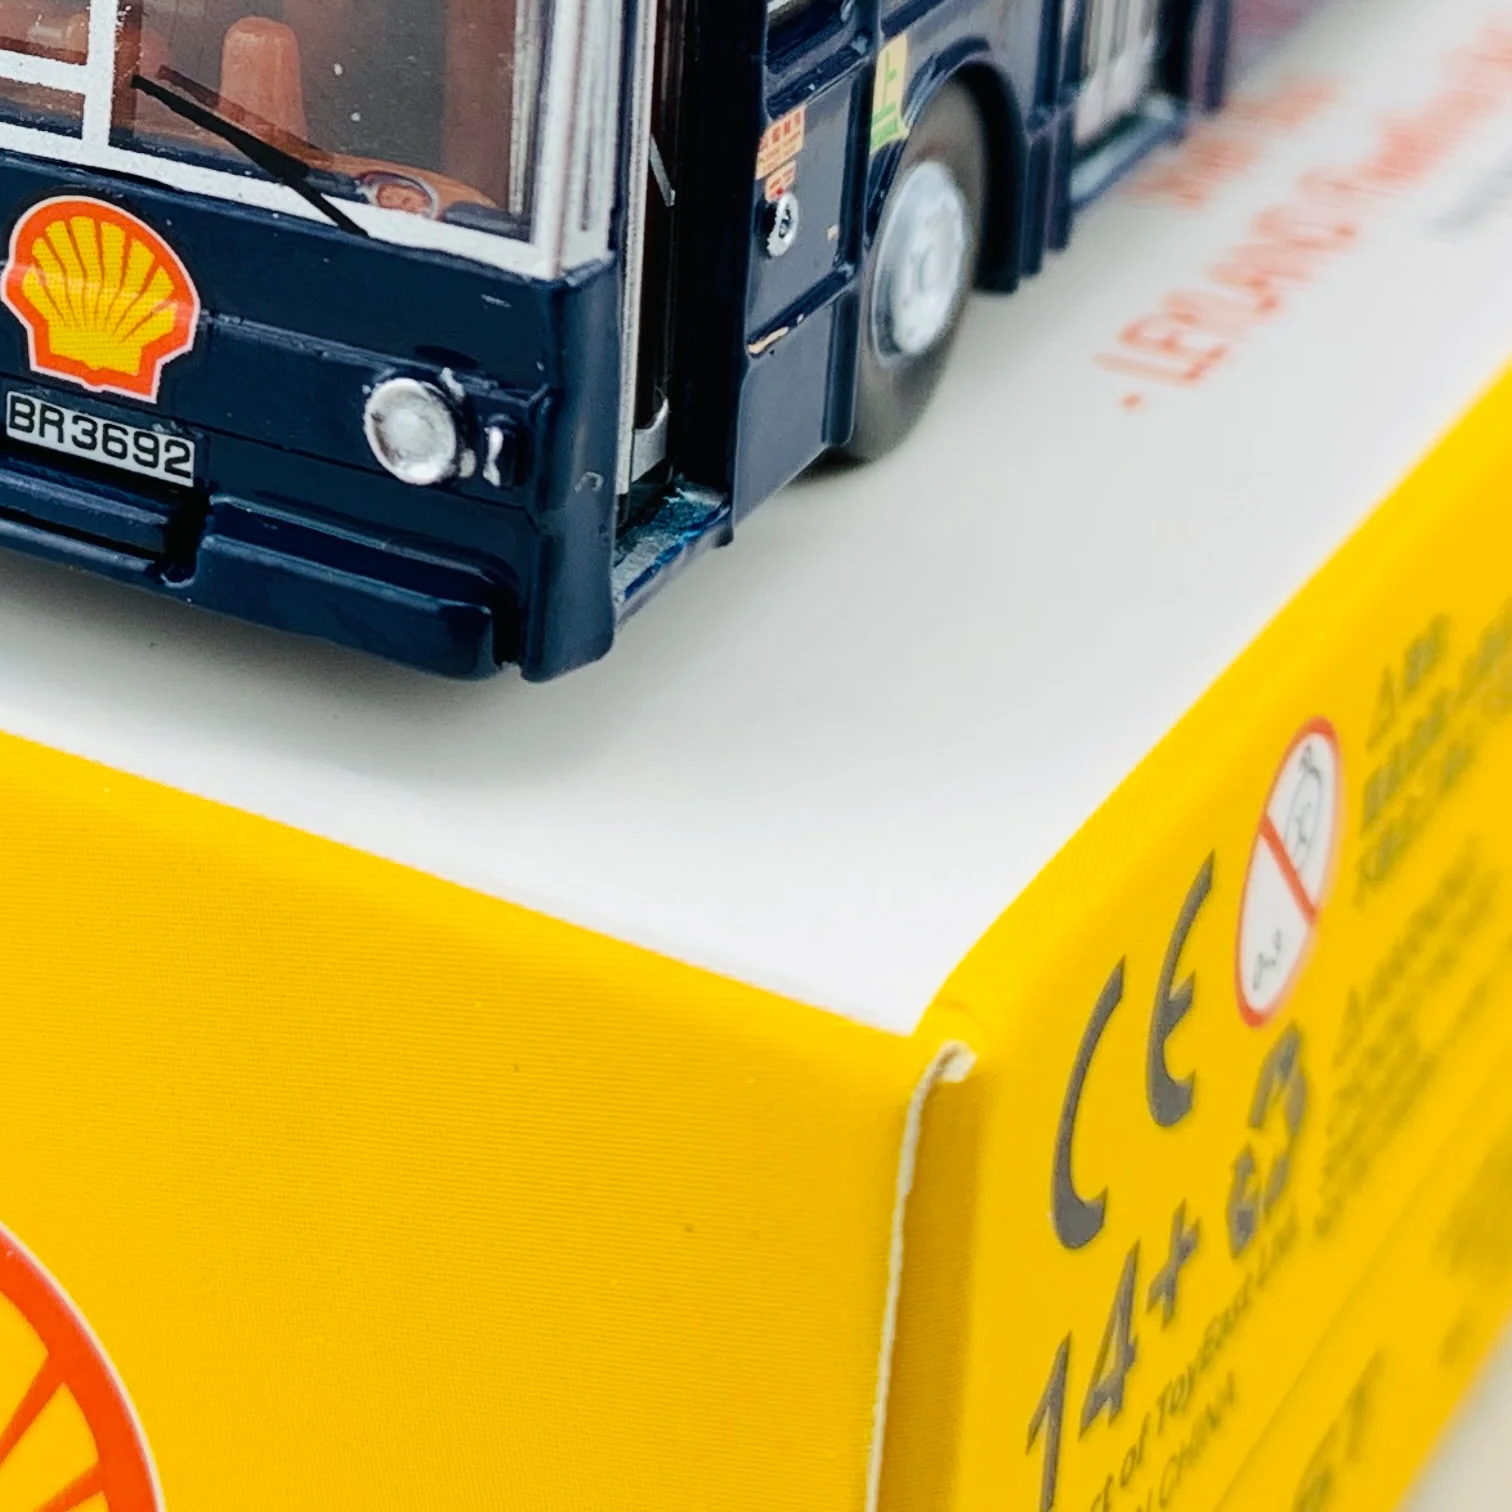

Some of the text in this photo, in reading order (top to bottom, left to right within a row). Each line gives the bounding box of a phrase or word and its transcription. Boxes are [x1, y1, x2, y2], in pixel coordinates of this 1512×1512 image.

[8, 395, 192, 479] BR3692
[1050, 848, 1216, 1250] CE
[1025, 1198, 1200, 1512] 14+
